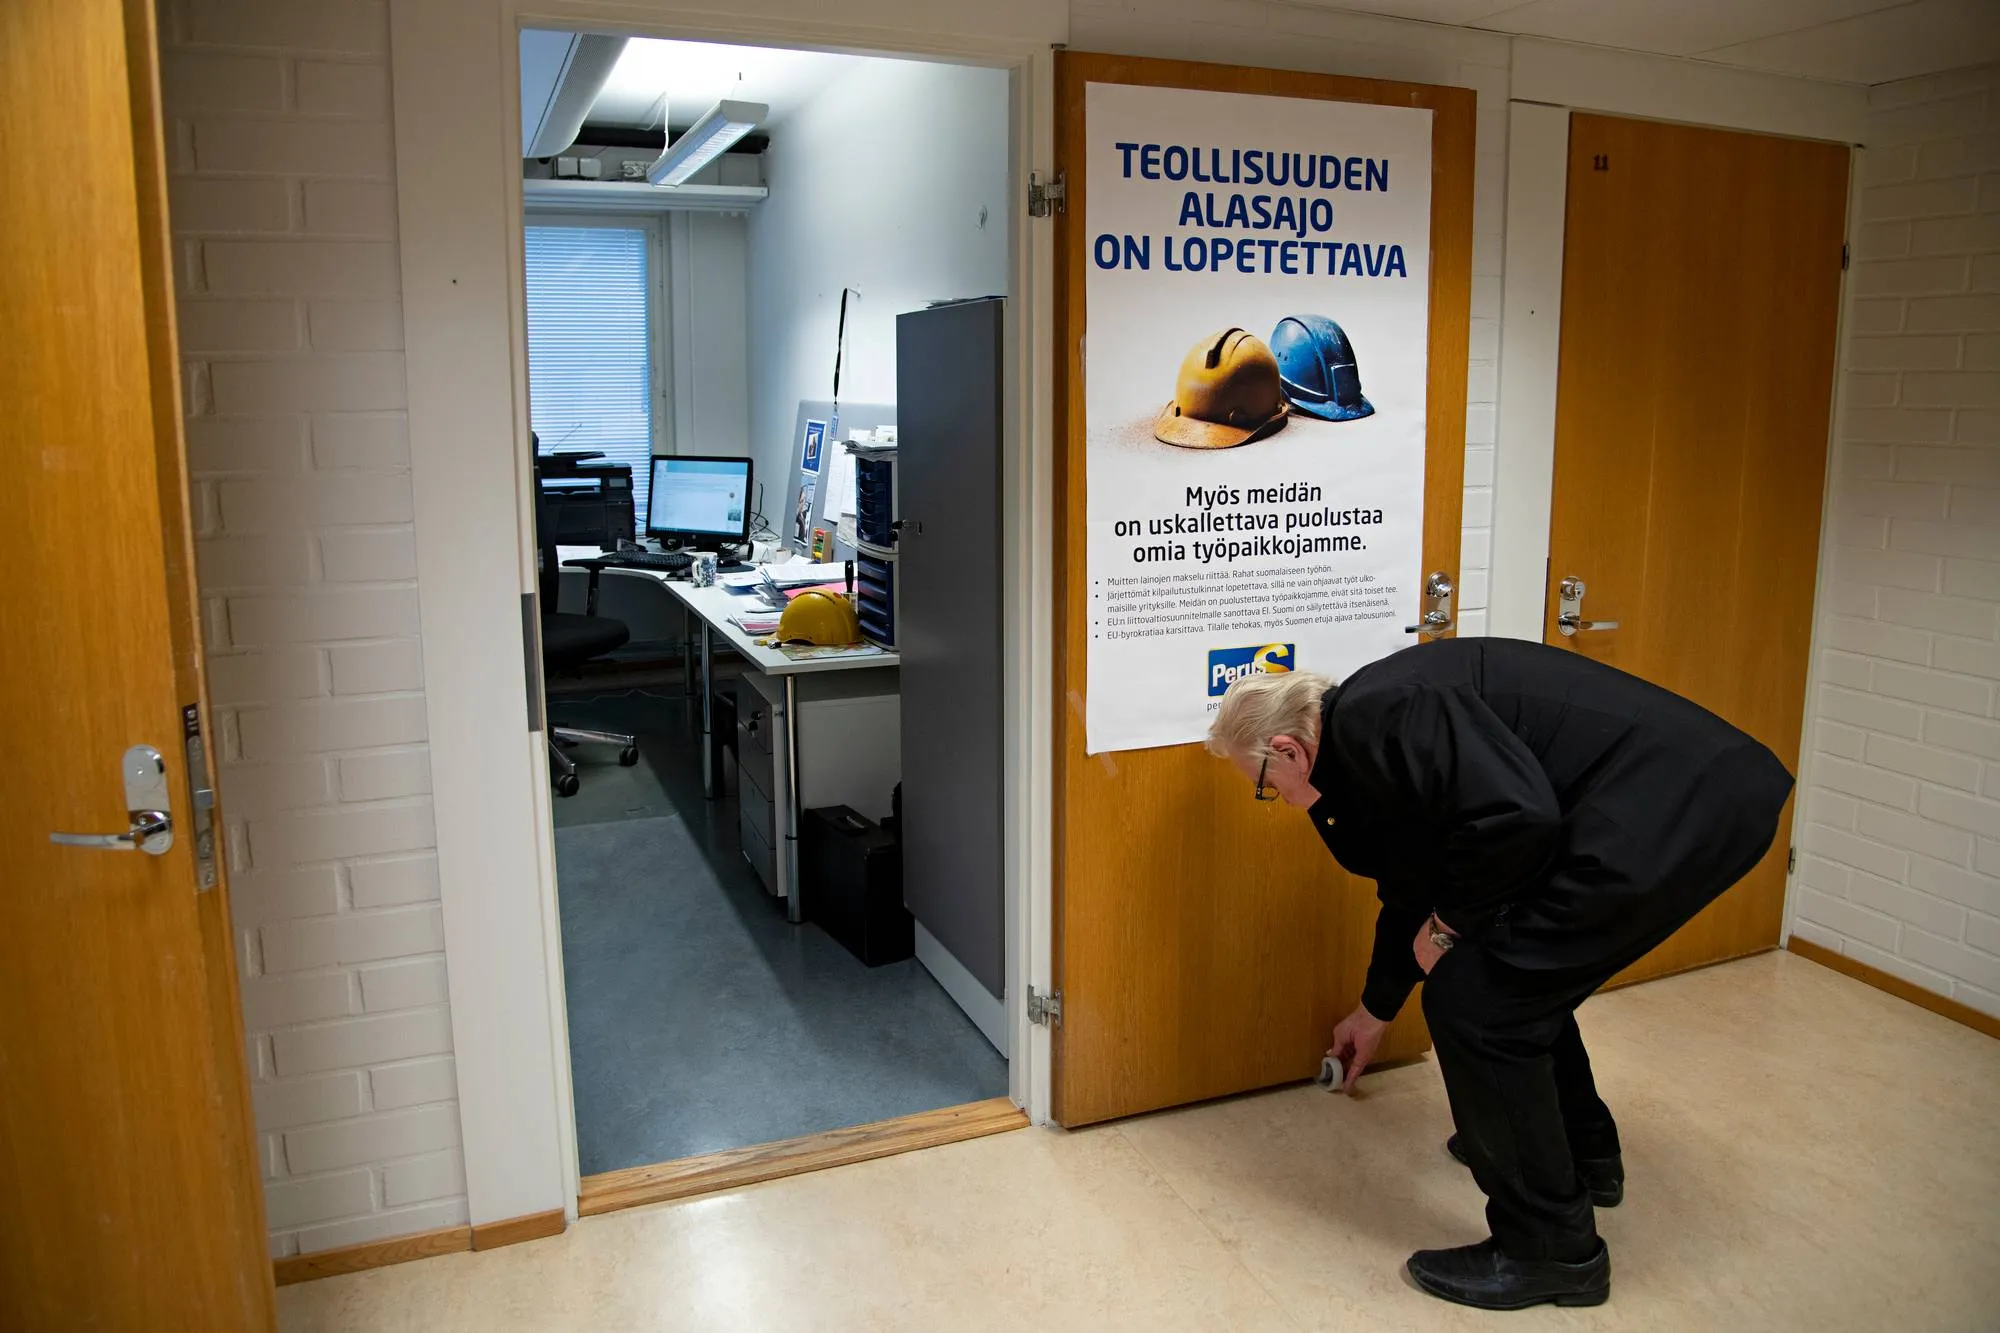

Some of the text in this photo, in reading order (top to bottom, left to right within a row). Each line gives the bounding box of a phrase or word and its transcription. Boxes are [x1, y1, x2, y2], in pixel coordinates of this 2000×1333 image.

[1115, 142, 1388, 192] TEOLLISUUDEN
[1593, 154, 1609, 171] 11
[1178, 192, 1333, 238] ALASAJO
[1094, 234, 1407, 277] ON LOPETETTAVA
[1186, 483, 1322, 511] Myös meidän
[1114, 507, 1383, 537] on uskallettava puolustaa
[1133, 534, 1367, 563] omia työpaikkojamme.
[1107, 577, 1138, 586] Muitten
[1140, 576, 1171, 585] lainojen
[1172, 573, 1204, 582] makselu
[1232, 569, 1254, 578] Rahat
[1256, 566, 1305, 577] suomalaiseen
[1107, 590, 1150, 601] Järjettömät
[1152, 585, 1223, 597] kilpailutustulkinnat
[1297, 579, 1312, 587] vain
[1313, 577, 1342, 587] ohjaavat
[1344, 576, 1358, 585] työt
[1360, 574, 1376, 582] ulko-
[1107, 604, 1137, 613] maisille
[1179, 599, 1206, 608] Meidän
[1219, 595, 1270, 607] puolustettava
[1331, 589, 1348, 597] eivät
[1127, 611, 1221, 625] liittovaltiosuunnitelmalle
[1224, 608, 1260, 618] sanottava
[1273, 605, 1294, 614] Suomi
[1306, 601, 1348, 612] säilytettävä
[1107, 628, 1164, 640] EU-byrokratiaa
[1208, 623, 1229, 631] Tilalle
[1232, 621, 1262, 630] tehokas,
[1264, 619, 1284, 629] myös
[1285, 616, 1313, 626] Suomen
[1315, 615, 1332, 624] etuja
[1334, 614, 1353, 623] ajava
